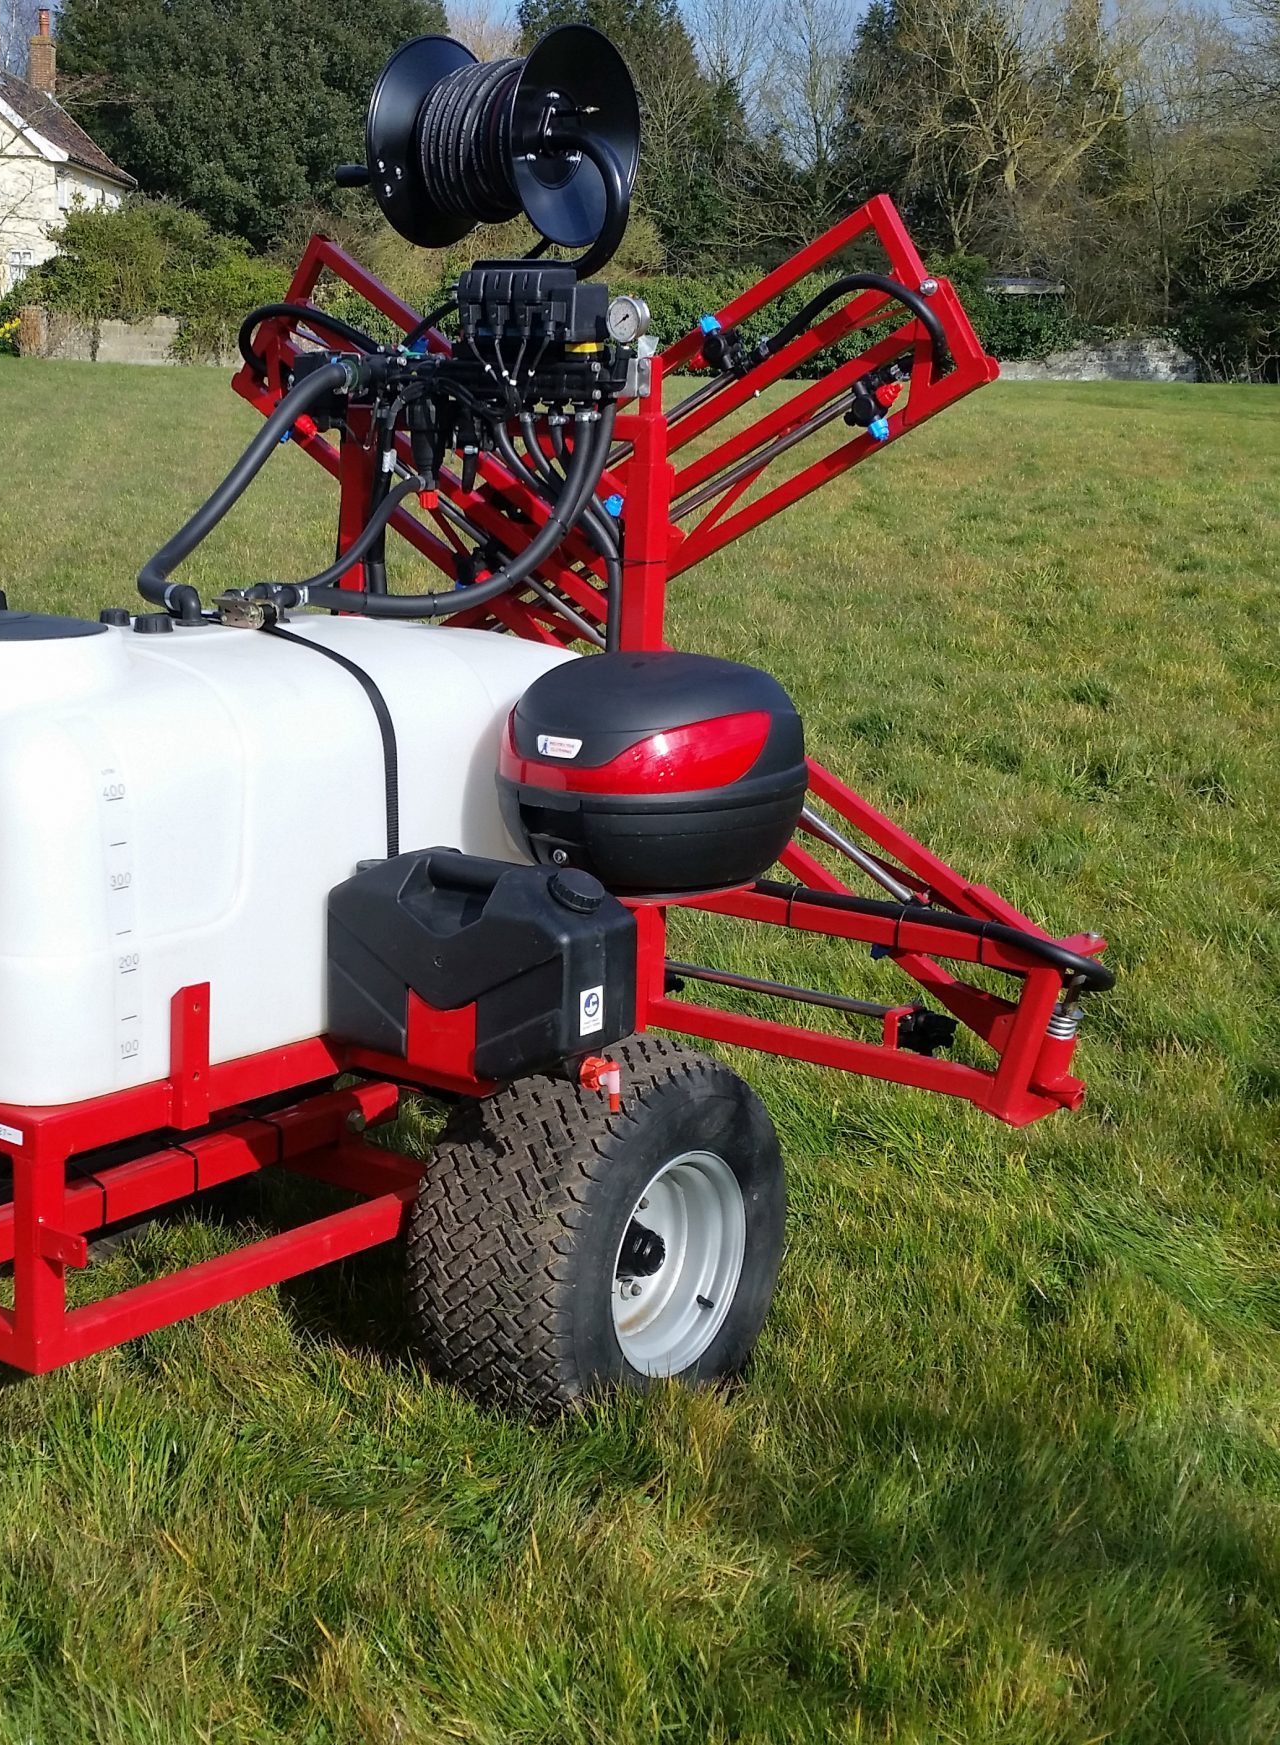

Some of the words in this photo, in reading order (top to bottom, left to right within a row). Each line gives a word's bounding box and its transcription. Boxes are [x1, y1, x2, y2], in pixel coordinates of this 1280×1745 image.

[103, 783, 126, 797] 400
[111, 872, 132, 887] 300
[119, 953, 140, 969] 200
[120, 1039, 139, 1054] 100
